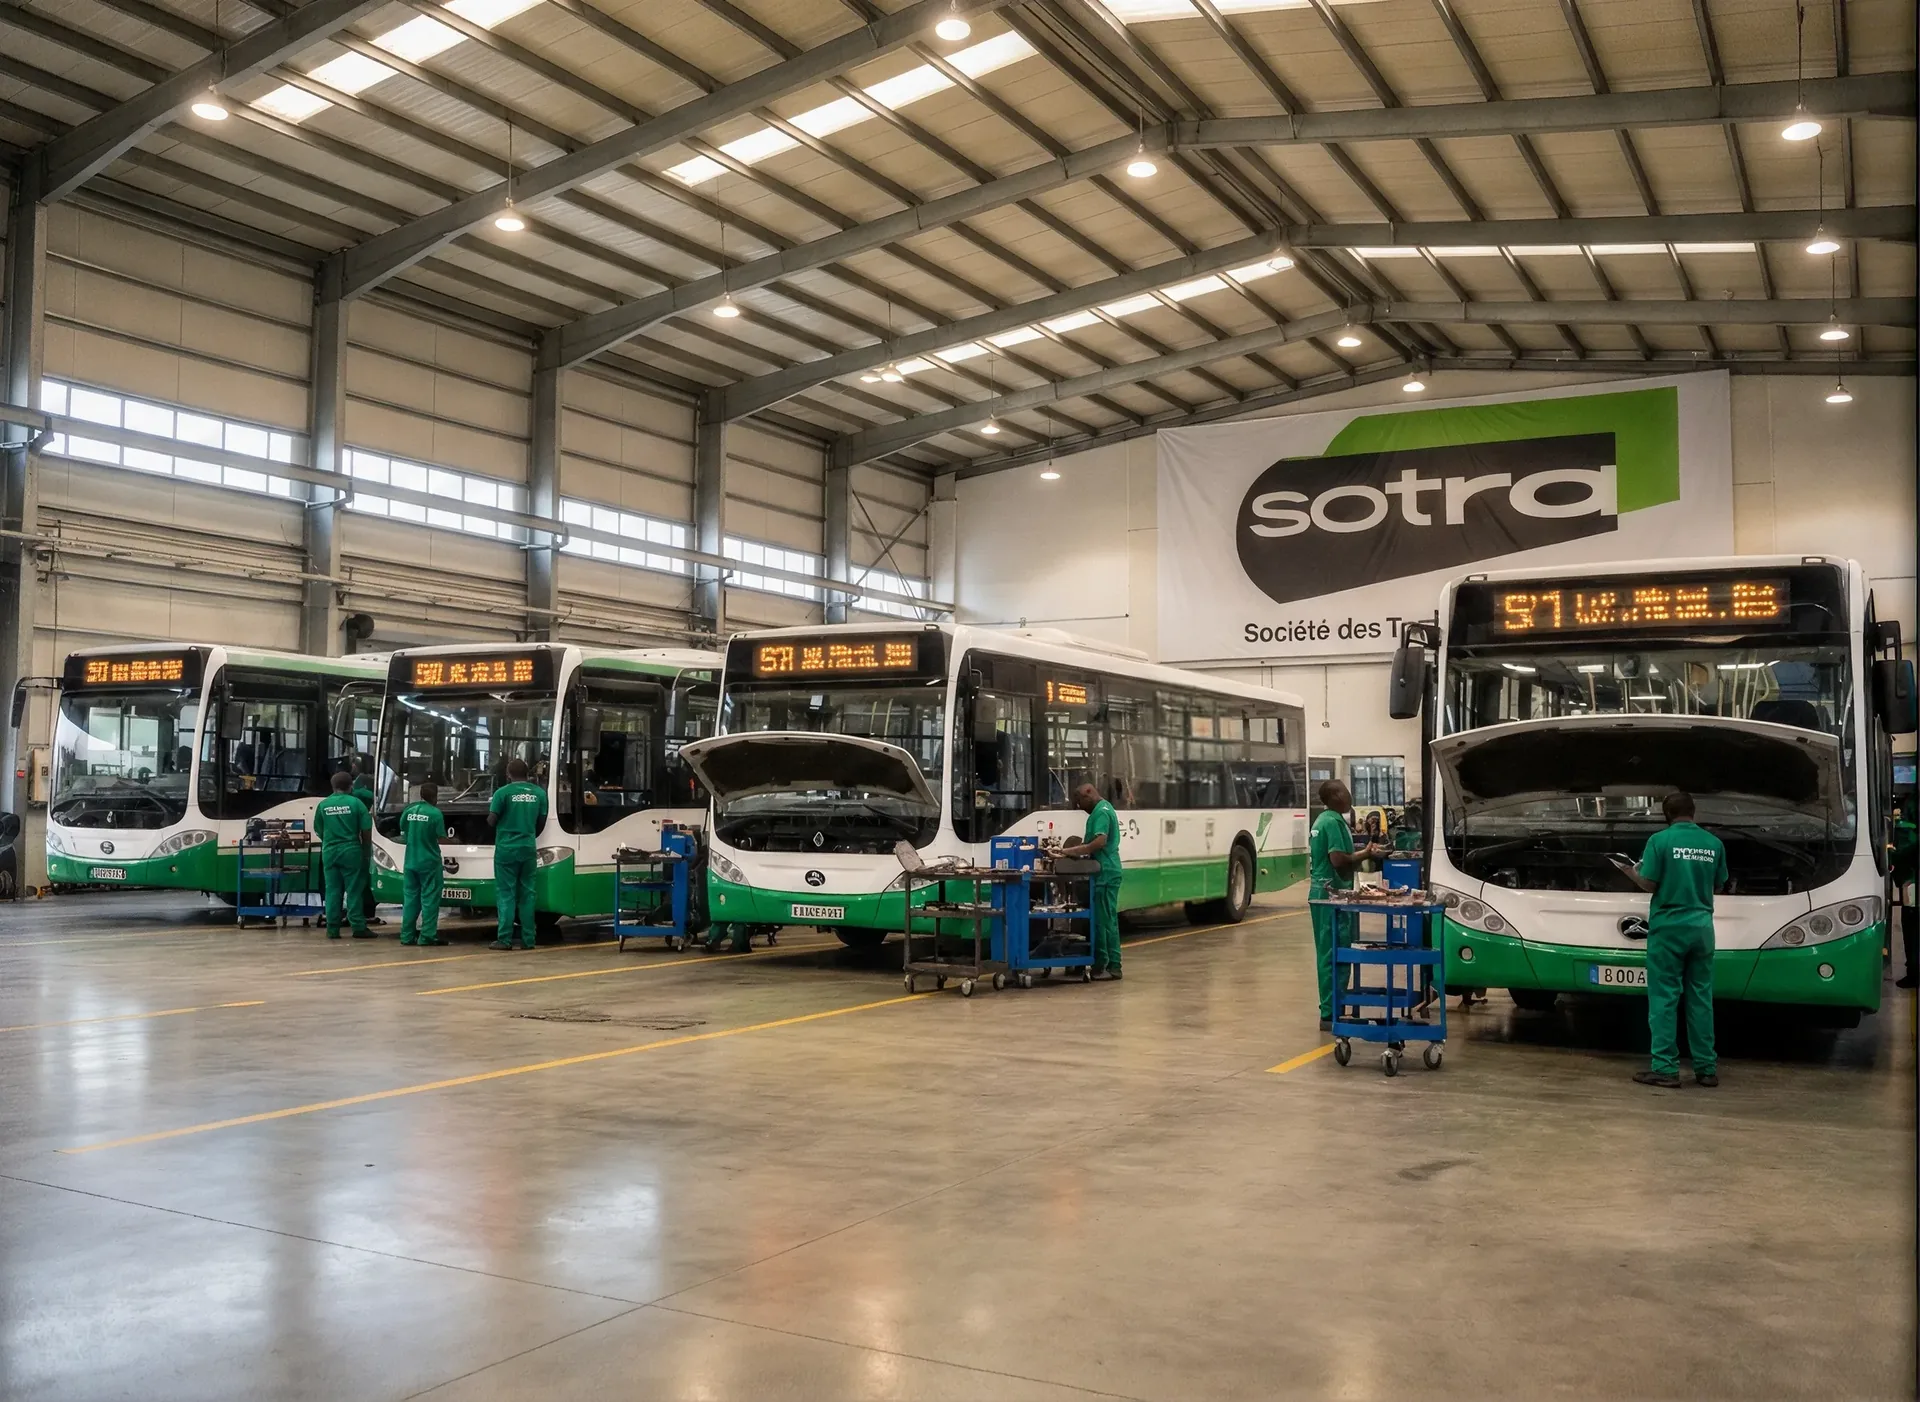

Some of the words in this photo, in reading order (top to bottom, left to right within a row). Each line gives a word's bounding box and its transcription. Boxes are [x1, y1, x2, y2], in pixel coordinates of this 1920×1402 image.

[1248, 464, 1618, 538] sotra
[1244, 619, 1330, 643] Société
[1338, 617, 1381, 640] des
[1386, 617, 1403, 638] T
